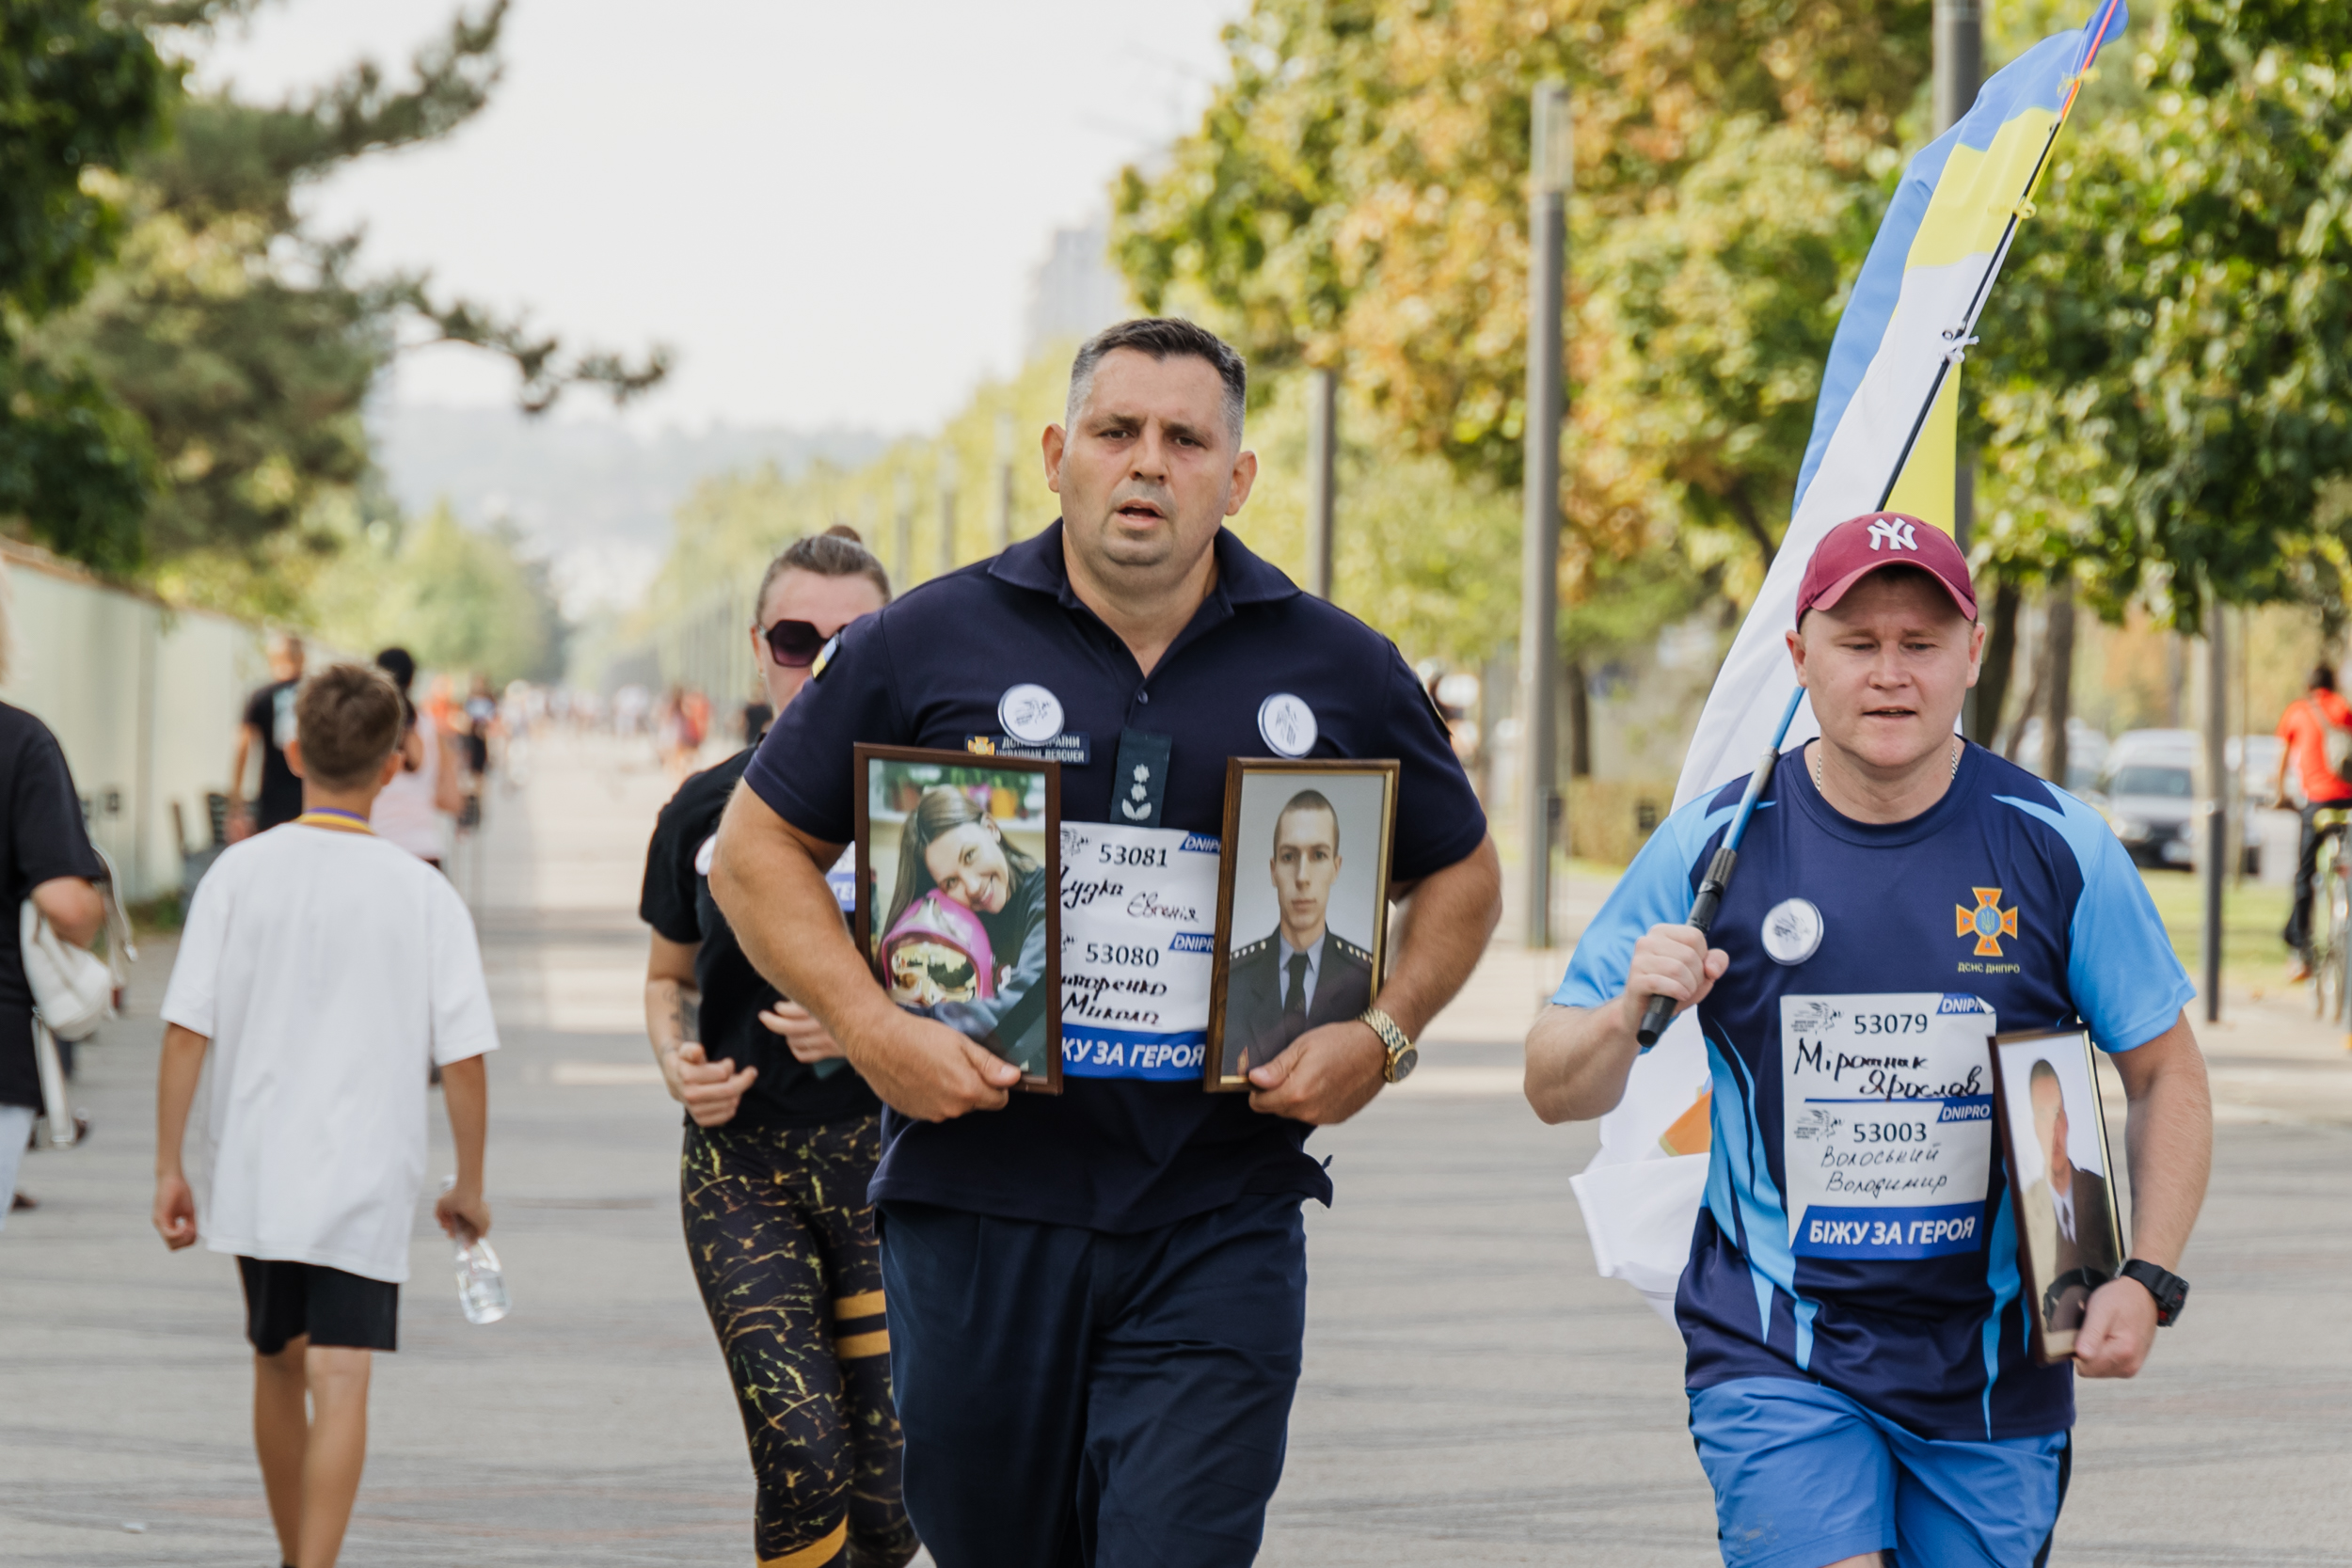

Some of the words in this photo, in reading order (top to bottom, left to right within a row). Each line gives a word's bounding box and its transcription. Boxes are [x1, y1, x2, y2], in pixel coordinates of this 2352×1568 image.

[1867, 517, 1918, 551] NY
[1099, 843, 1168, 868] 53081
[1184, 835, 1221, 853] DNIP
[1085, 942, 1160, 967] 53080
[1985, 962, 2021, 974] ДНІПРО
[1853, 1013, 1929, 1035] 53079
[1092, 1040, 1124, 1067] ЗА
[1129, 1043, 1206, 1069] ГЕРОЯ
[1859, 1066, 1983, 1102] Ярослав
[1942, 1103, 1991, 1121] DNIPRO
[1852, 1122, 1928, 1143] 53003
[1825, 1170, 1947, 1199] Володимир
[1809, 1219, 1870, 1245] БІЖУ
[1870, 1220, 1903, 1245] ЗА
[1908, 1216, 1976, 1245] ГЕРОЯ
